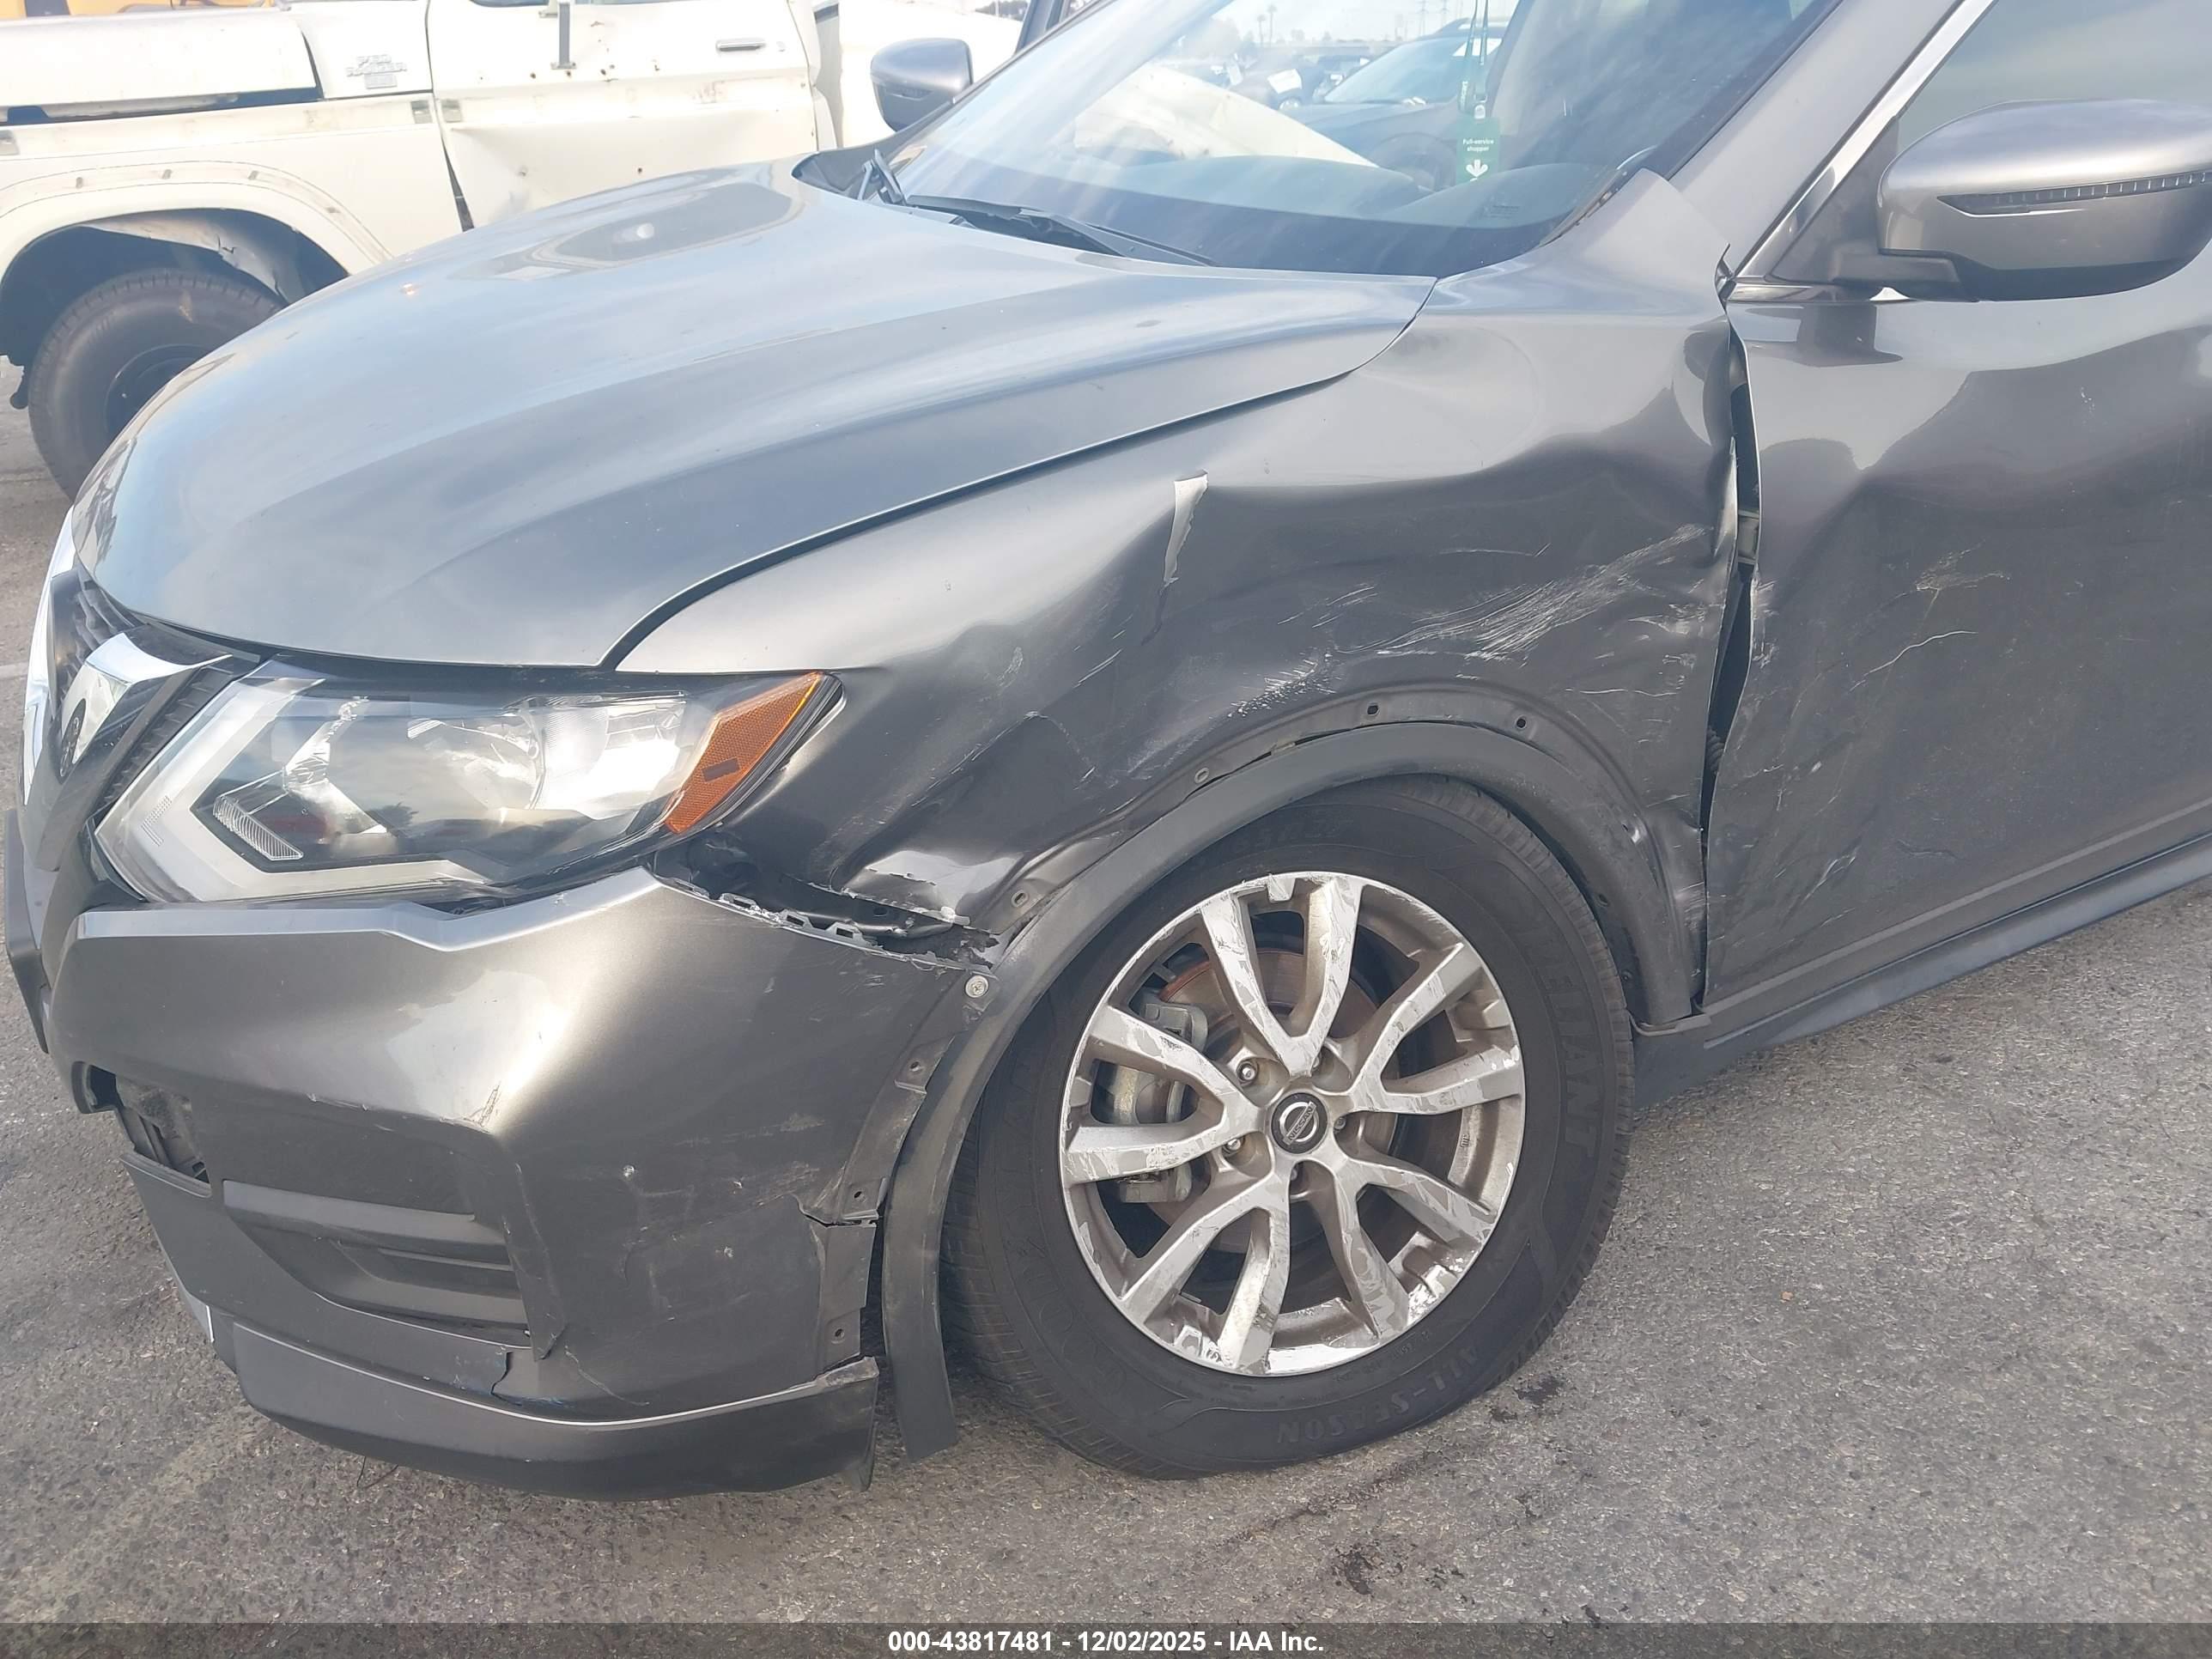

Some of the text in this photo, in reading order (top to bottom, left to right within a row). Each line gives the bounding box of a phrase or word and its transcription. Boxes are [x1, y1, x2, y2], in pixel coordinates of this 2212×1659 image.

[1467, 144, 1490, 153] shopper
[1288, 1105, 1314, 1141] NISSAN
[1277, 1346, 1480, 1444] ALL-SEASON
